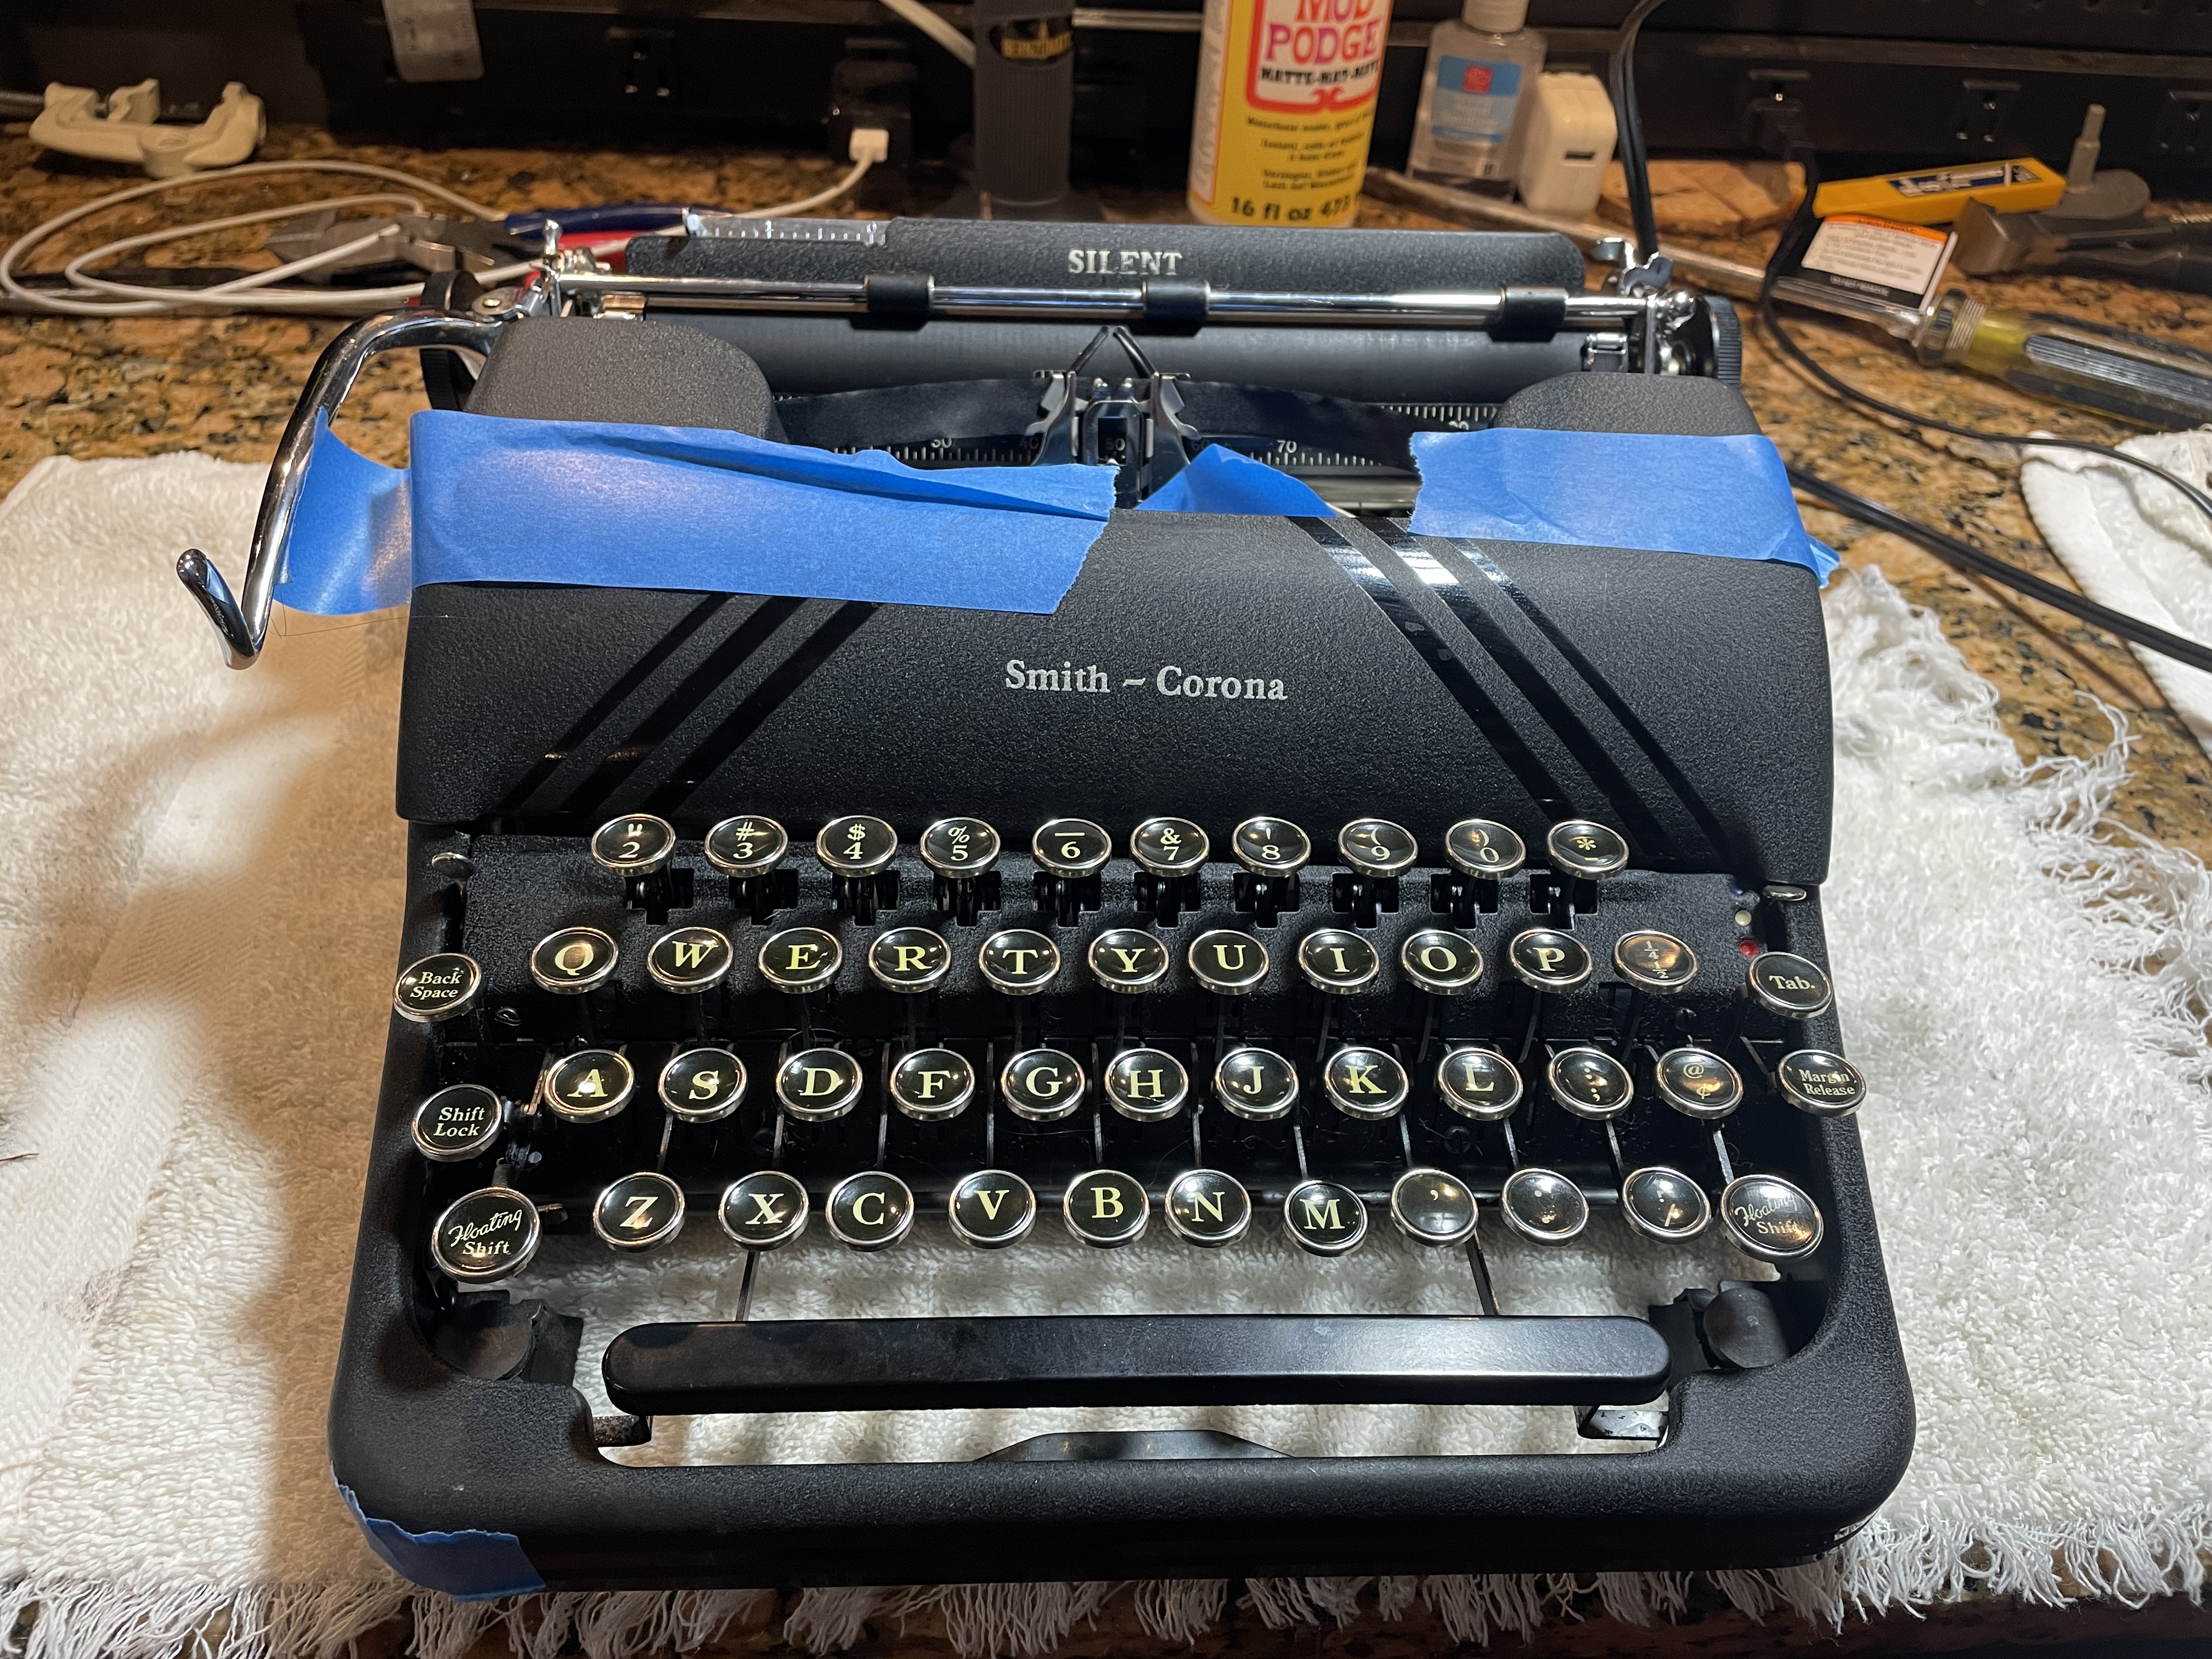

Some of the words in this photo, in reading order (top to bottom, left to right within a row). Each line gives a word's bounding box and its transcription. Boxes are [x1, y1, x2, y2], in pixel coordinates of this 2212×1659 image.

[1267, 19, 1380, 64] PODGE
[1231, 197, 1254, 217] 16
[1068, 249, 1182, 275] SILENT
[1277, 439, 1297, 453] 70
[1006, 659, 1110, 693] Smith
[1156, 665, 1288, 701] Corona
[736, 821, 754, 840] #
[847, 823, 866, 840] $
[948, 826, 970, 844] %
[1160, 828, 1182, 845] &
[1371, 827, 1381, 845] (
[1479, 829, 1489, 847] )
[619, 842, 641, 859] 2
[733, 842, 753, 859] 3
[843, 842, 863, 860] 4
[951, 845, 968, 861] 5
[1060, 842, 1080, 859] 6
[1163, 845, 1180, 861] 7
[1262, 845, 1280, 860] 8
[1371, 846, 1390, 861] 9
[555, 943, 594, 975] Q
[672, 941, 718, 969] W
[786, 944, 822, 970] E
[893, 946, 932, 972] R
[1002, 949, 1039, 974] T
[1111, 947, 1146, 973] Y
[1212, 944, 1247, 970] U
[1329, 948, 1350, 972] I
[1421, 946, 1457, 972] O
[1533, 947, 1566, 972] P
[419, 972, 463, 985] Back
[1769, 975, 1815, 990] Tab.
[410, 987, 459, 1000] Space
[567, 1069, 608, 1098] A
[799, 1067, 840, 1097] D
[1026, 1066, 1063, 1097] G
[1127, 1069, 1165, 1098] H
[1243, 1065, 1265, 1094] J
[1345, 1064, 1387, 1094] K
[1462, 1063, 1495, 1092] L
[1683, 1063, 1705, 1079] @
[1798, 1069, 1850, 1084] Margin
[689, 1070, 719, 1100] S
[917, 1070, 951, 1098] F
[1803, 1083, 1855, 1096] Release
[439, 1107, 485, 1121] Shift
[433, 1122, 479, 1137] Lock
[619, 1196, 659, 1228] Z
[746, 1193, 785, 1224] X
[853, 1192, 885, 1226] C
[974, 1189, 1009, 1221] V
[1090, 1187, 1124, 1219] B
[1191, 1191, 1226, 1223] N
[1299, 1198, 1345, 1230] M
[1734, 1192, 1797, 1227] Floating
[448, 1209, 522, 1248] Floating
[462, 1240, 510, 1255] Shift
